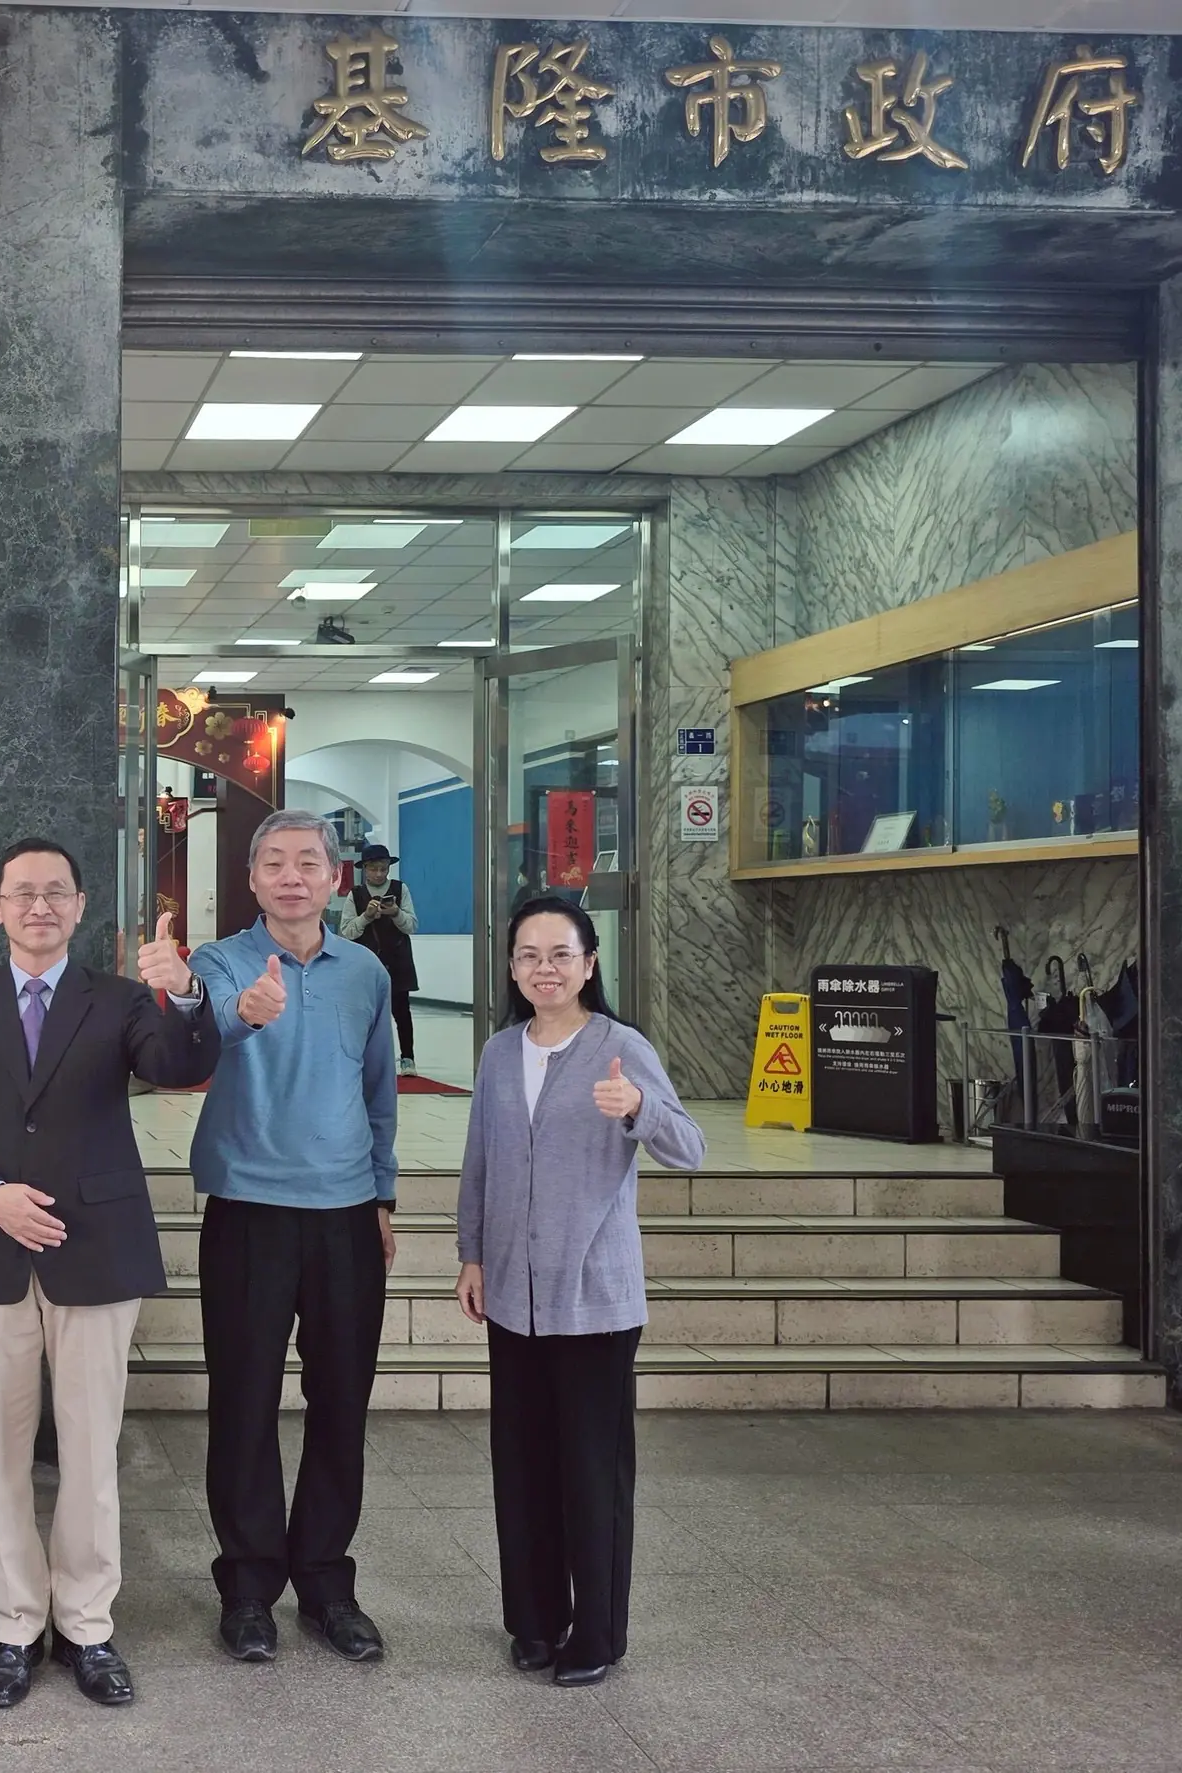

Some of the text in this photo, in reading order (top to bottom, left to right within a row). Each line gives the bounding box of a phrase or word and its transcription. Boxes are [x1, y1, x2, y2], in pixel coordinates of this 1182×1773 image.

[301, 33, 1142, 174] 基隆市政府
[698, 743, 702, 753] 1
[817, 978, 880, 994] 雨傘除水器
[758, 1078, 804, 1094] 小心地滑
